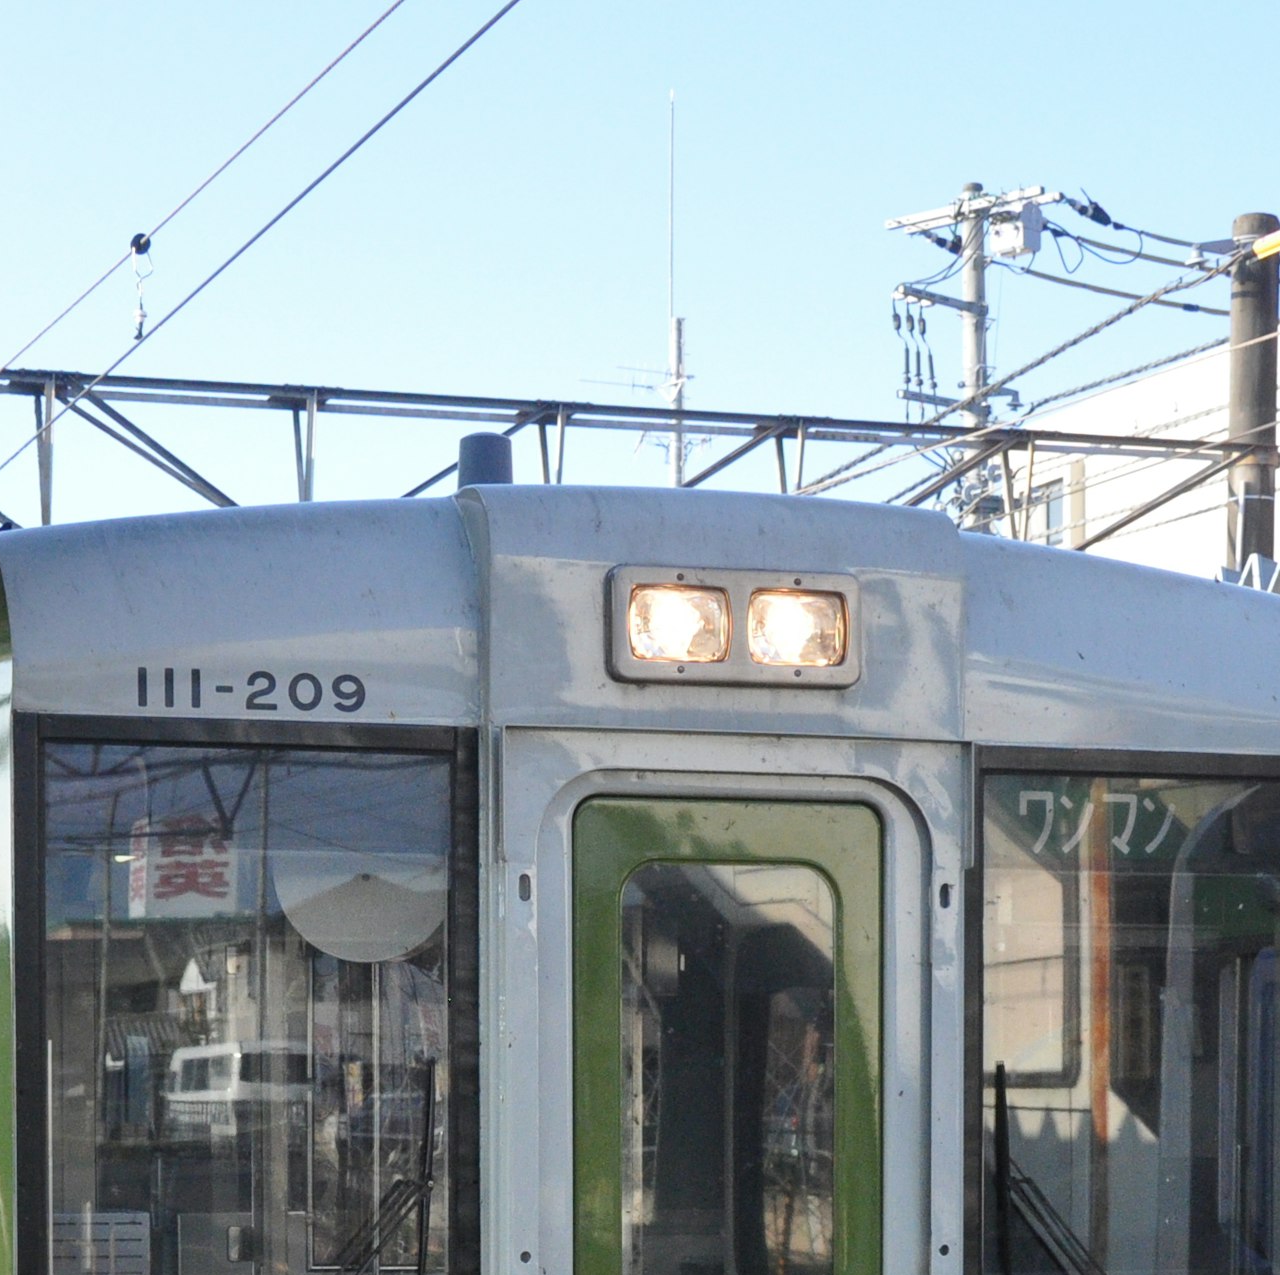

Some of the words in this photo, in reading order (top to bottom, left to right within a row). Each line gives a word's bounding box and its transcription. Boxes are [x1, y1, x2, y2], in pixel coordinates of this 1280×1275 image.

[137, 665, 367, 714] 111-209
[1018, 789, 1179, 856] ワンマン
